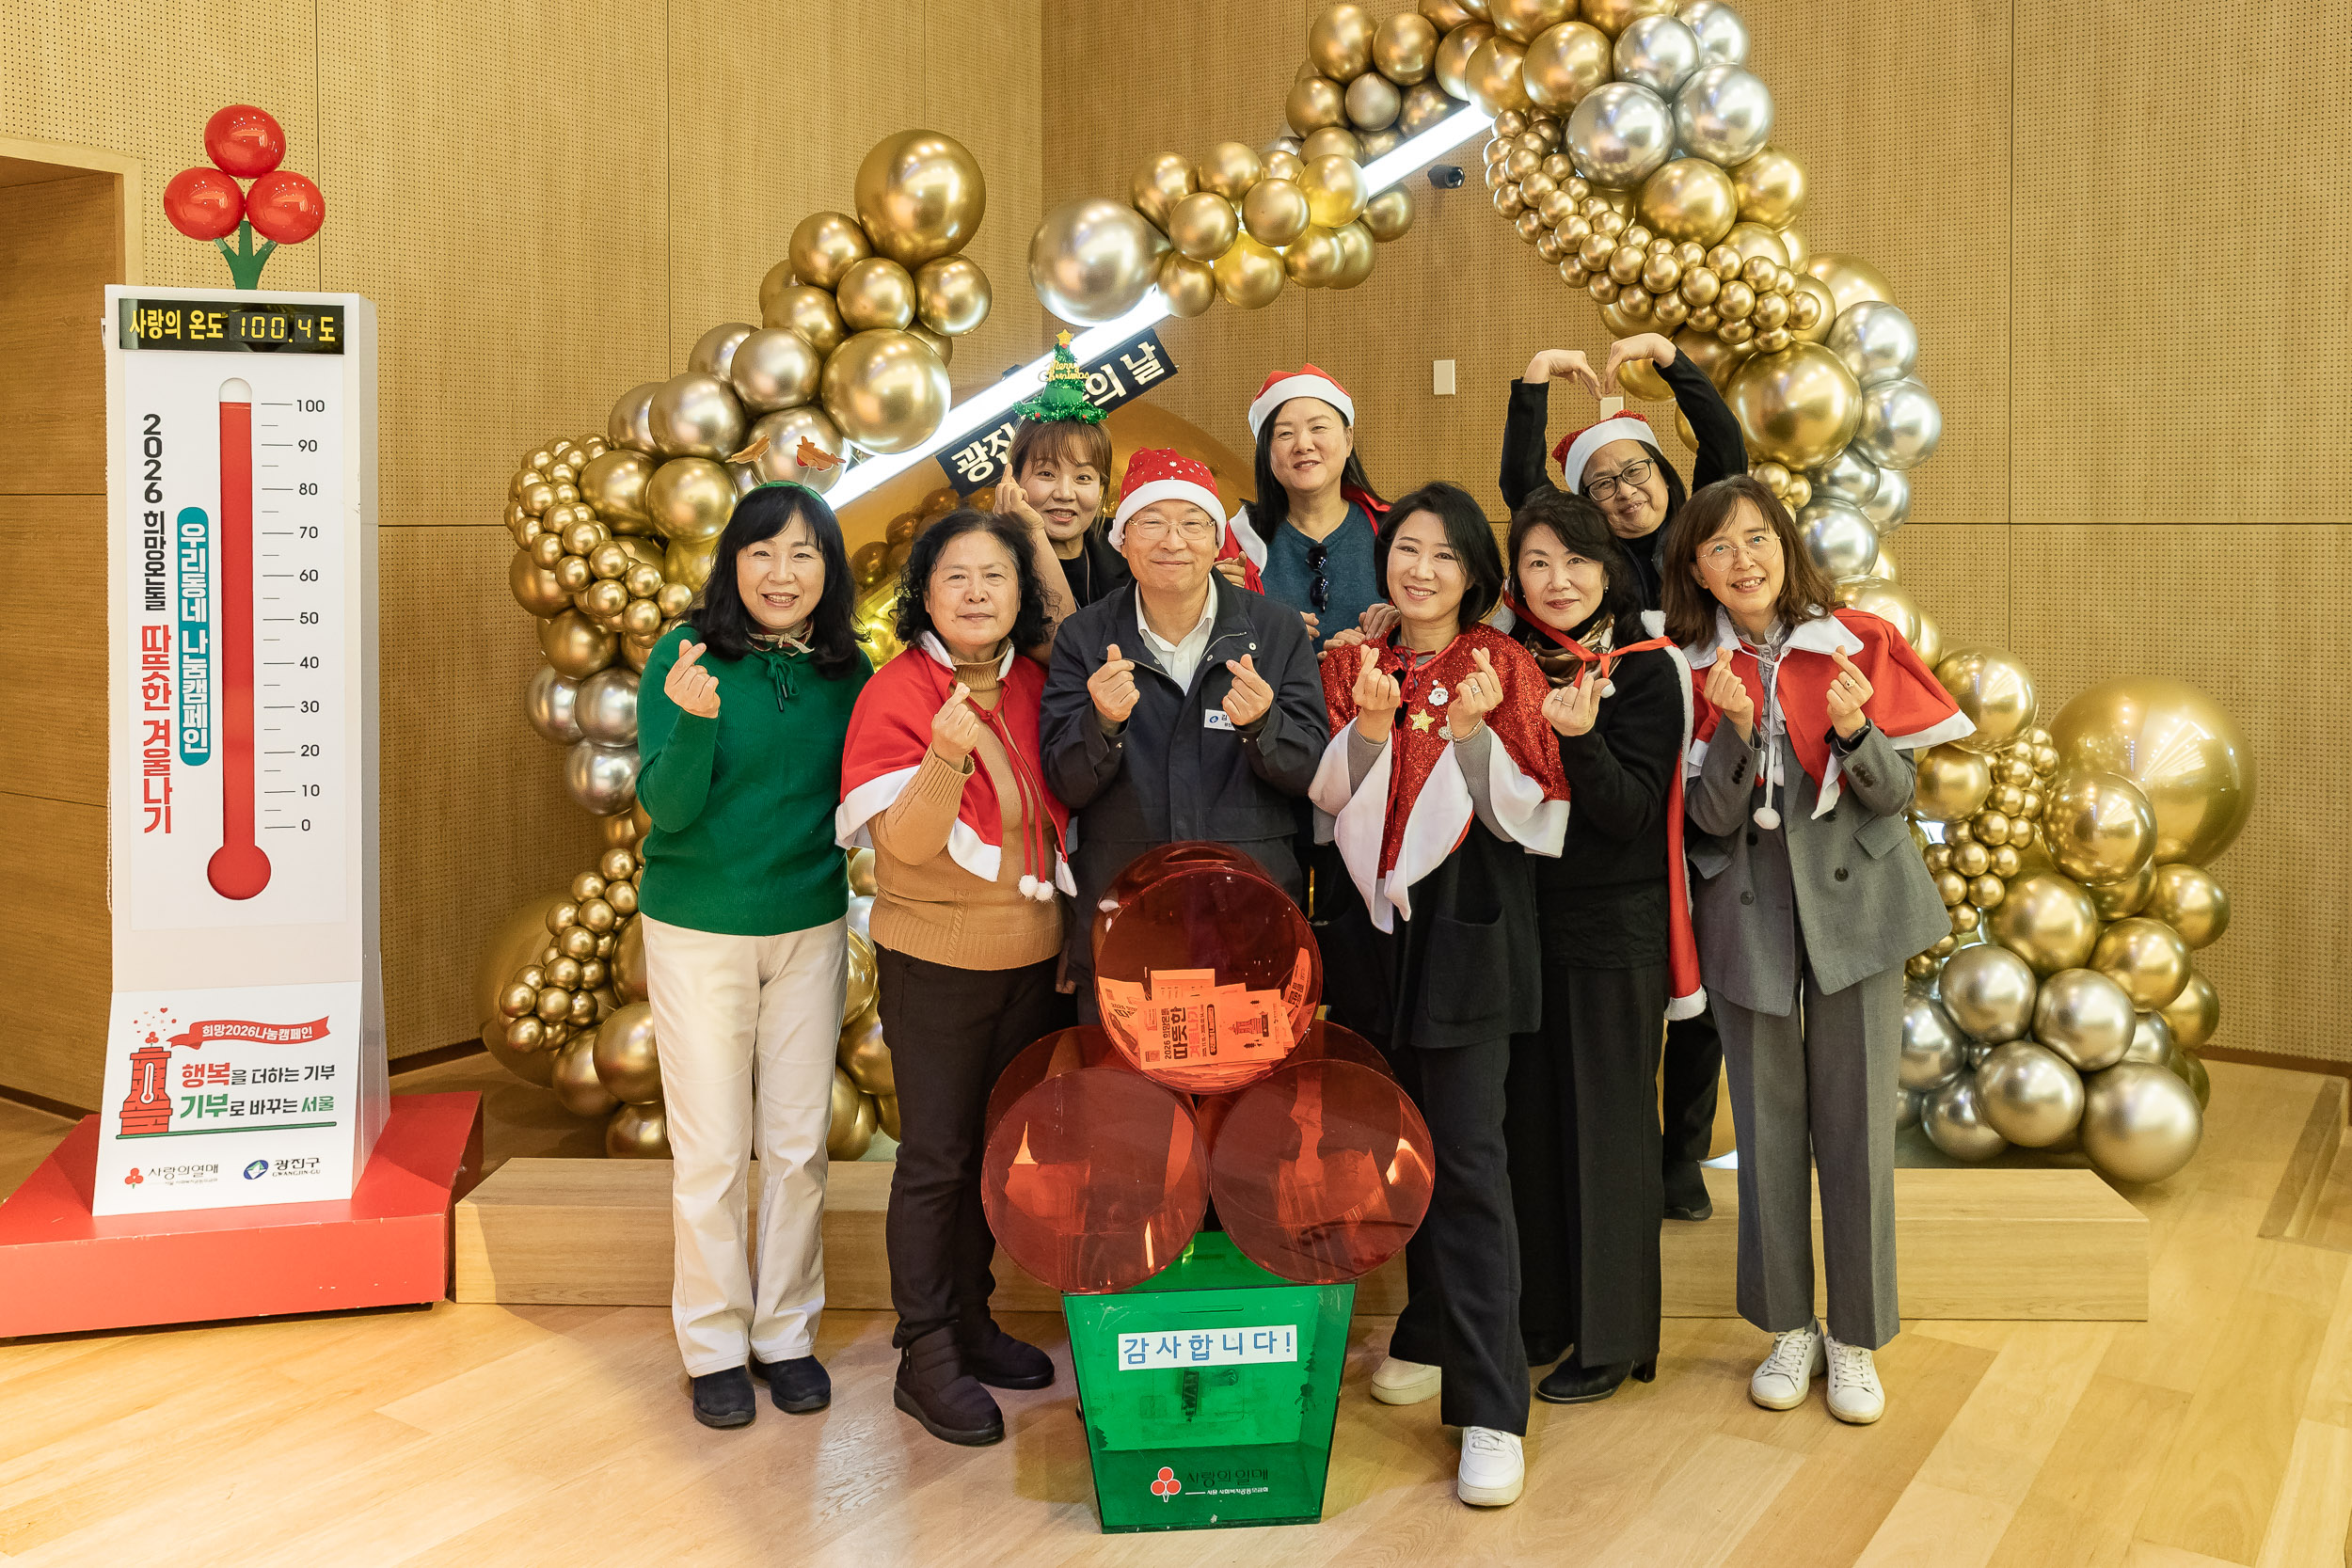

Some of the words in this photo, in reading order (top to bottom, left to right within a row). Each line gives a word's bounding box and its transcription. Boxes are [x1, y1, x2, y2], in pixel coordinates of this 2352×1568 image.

[129, 308, 182, 340] 사랑의
[188, 309, 225, 340] 온도
[1120, 341, 1166, 386] 날
[296, 399, 326, 413] 100
[297, 439, 318, 453] 90
[143, 413, 164, 504] 2026
[298, 483, 318, 497] 80
[299, 526, 319, 539] 70
[143, 510, 167, 611] 희망온돌
[180, 522, 208, 623] 우리동네
[299, 569, 319, 582] 60
[299, 611, 319, 625] 50
[141, 624, 172, 712] 따뜻한
[299, 656, 320, 669] 40
[181, 628, 209, 754] 나눔캠페인
[299, 700, 320, 713] 30
[300, 744, 320, 757] 20
[142, 719, 173, 834] 겨울나기
[301, 784, 320, 797] 10
[301, 818, 311, 832] 0
[201, 1024, 313, 1041] 희망2026나눔캠페인
[1170, 1006, 1188, 1060] 따뜻한
[1186, 1006, 1200, 1058] 겨울나기
[181, 1062, 247, 1088] 행복을
[250, 1067, 300, 1085] 더하는
[303, 1064, 336, 1082] 기부
[179, 1093, 246, 1119] 기부로
[249, 1098, 298, 1117] 바꾸는
[301, 1095, 335, 1113] 서울
[274, 1157, 322, 1171] 광진구
[1122, 1330, 1292, 1365] 감사합니다!
